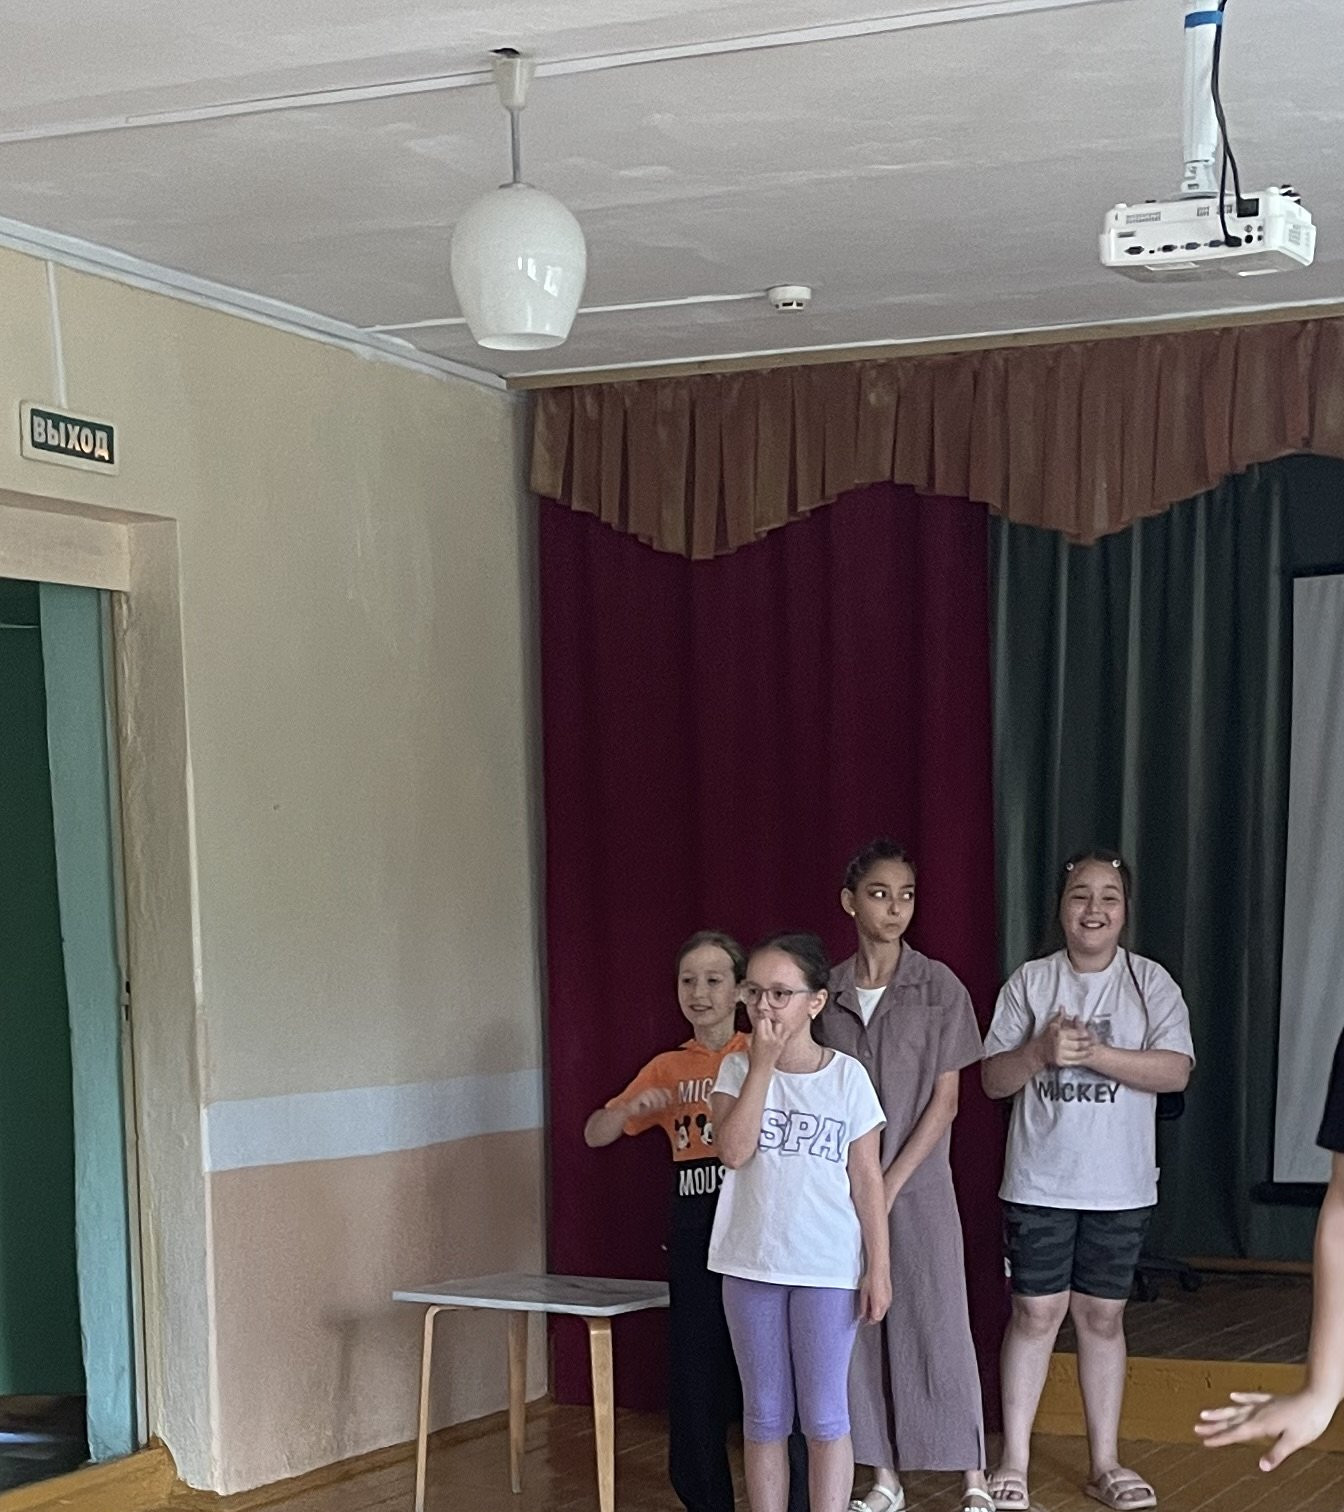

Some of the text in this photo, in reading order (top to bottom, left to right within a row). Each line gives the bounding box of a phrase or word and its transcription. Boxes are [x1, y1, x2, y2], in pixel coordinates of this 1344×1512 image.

[32, 415, 109, 461] ВЫХОД
[677, 1077, 714, 1104] MIC
[1038, 1081, 1121, 1104] MICKEY
[679, 1165, 726, 1197] MOUS
